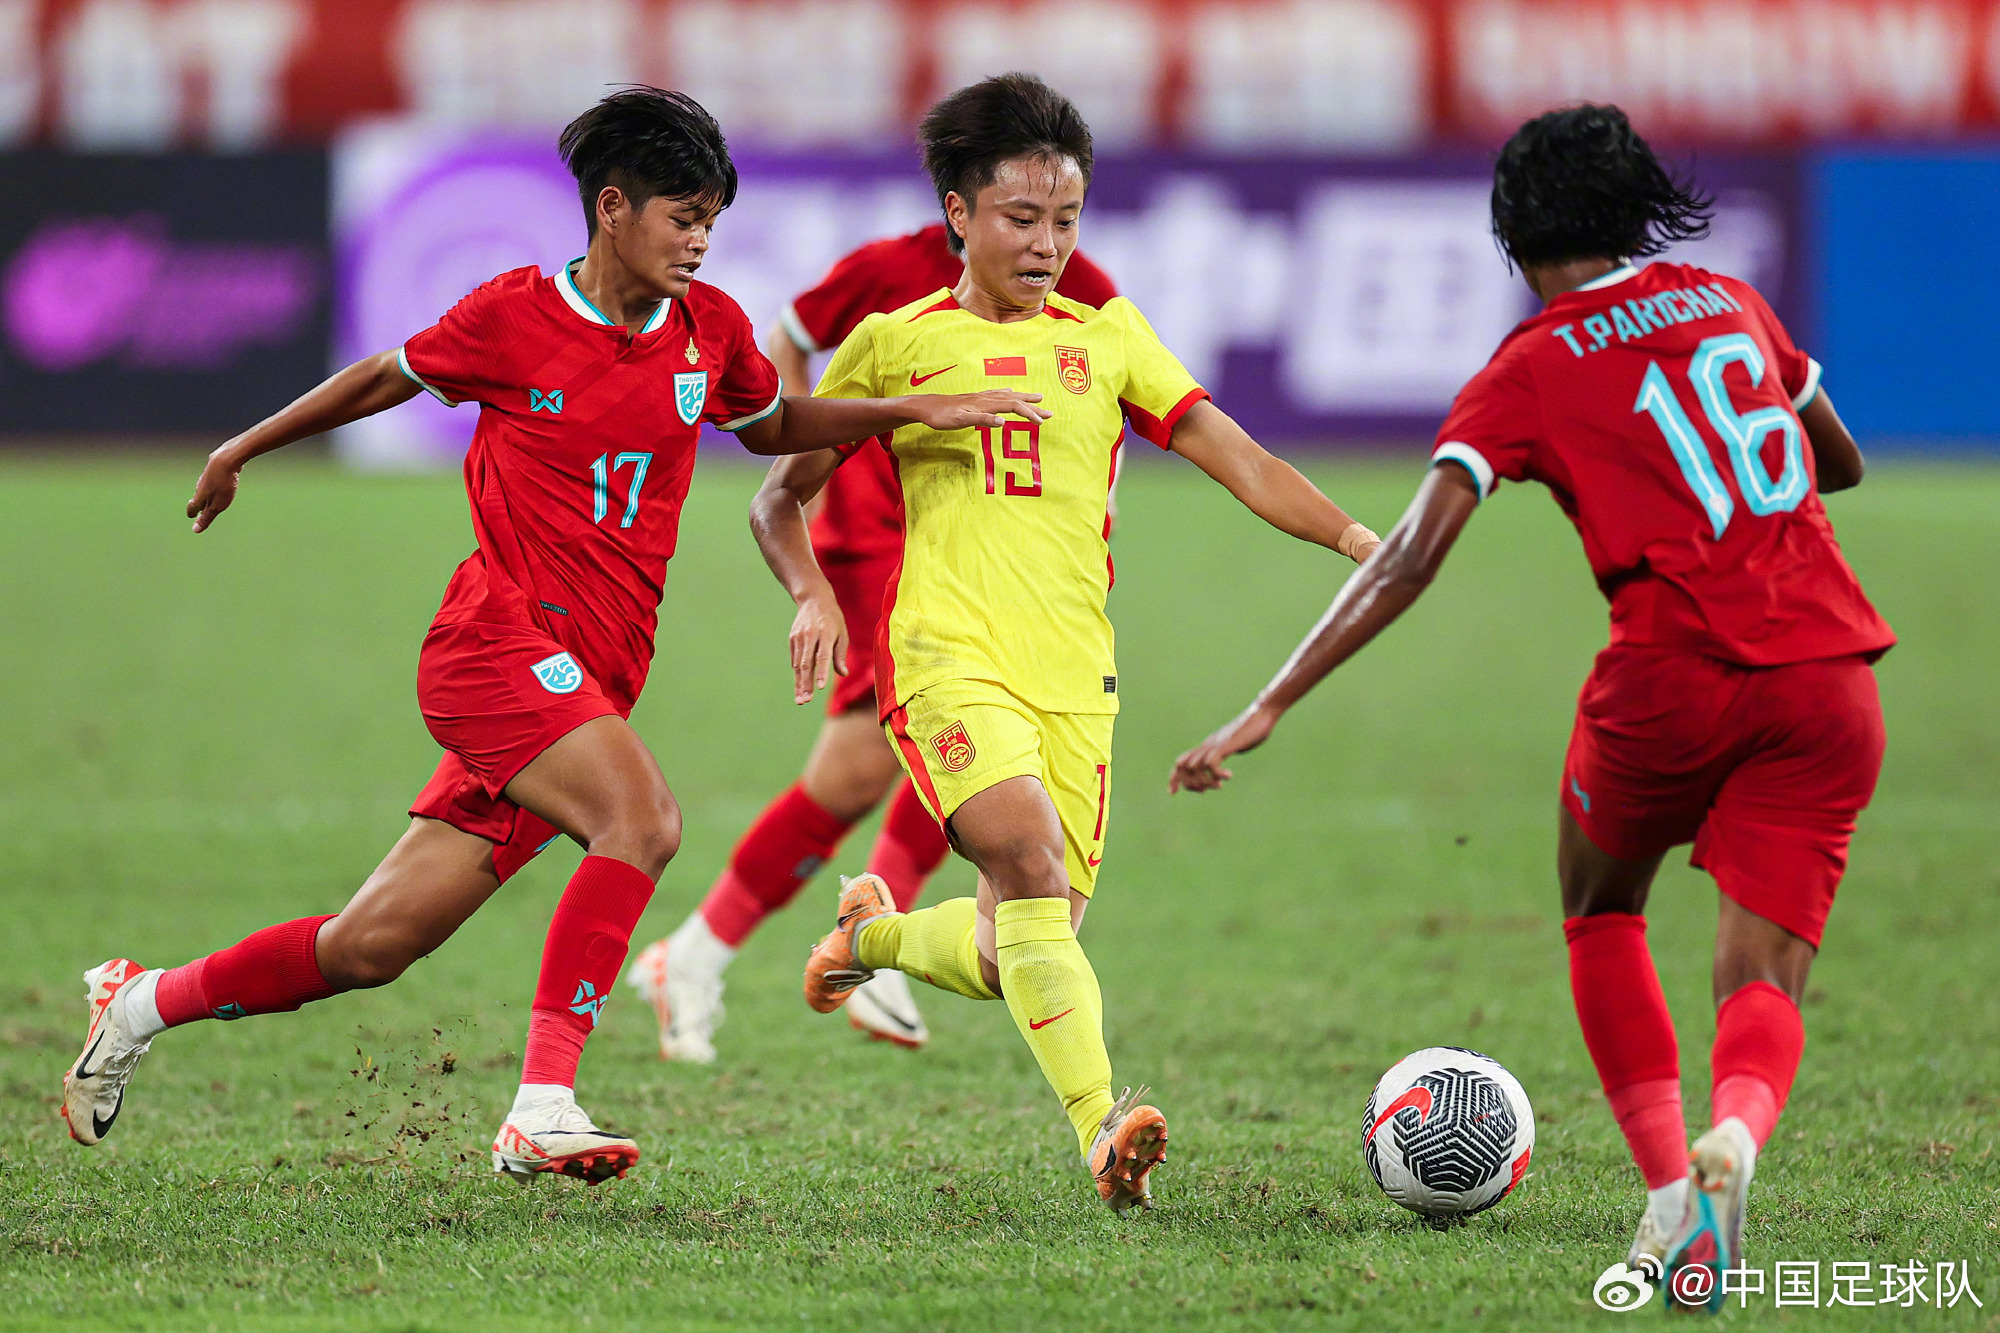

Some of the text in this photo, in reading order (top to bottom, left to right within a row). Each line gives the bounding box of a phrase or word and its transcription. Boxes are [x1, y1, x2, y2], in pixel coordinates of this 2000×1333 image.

[678, 375, 704, 383] THAILAND
[1059, 350, 1085, 361] CFA
[975, 420, 1042, 497] 19
[1634, 332, 1810, 540] 16
[588, 452, 653, 528] 17
[934, 726, 962, 748] CFA
